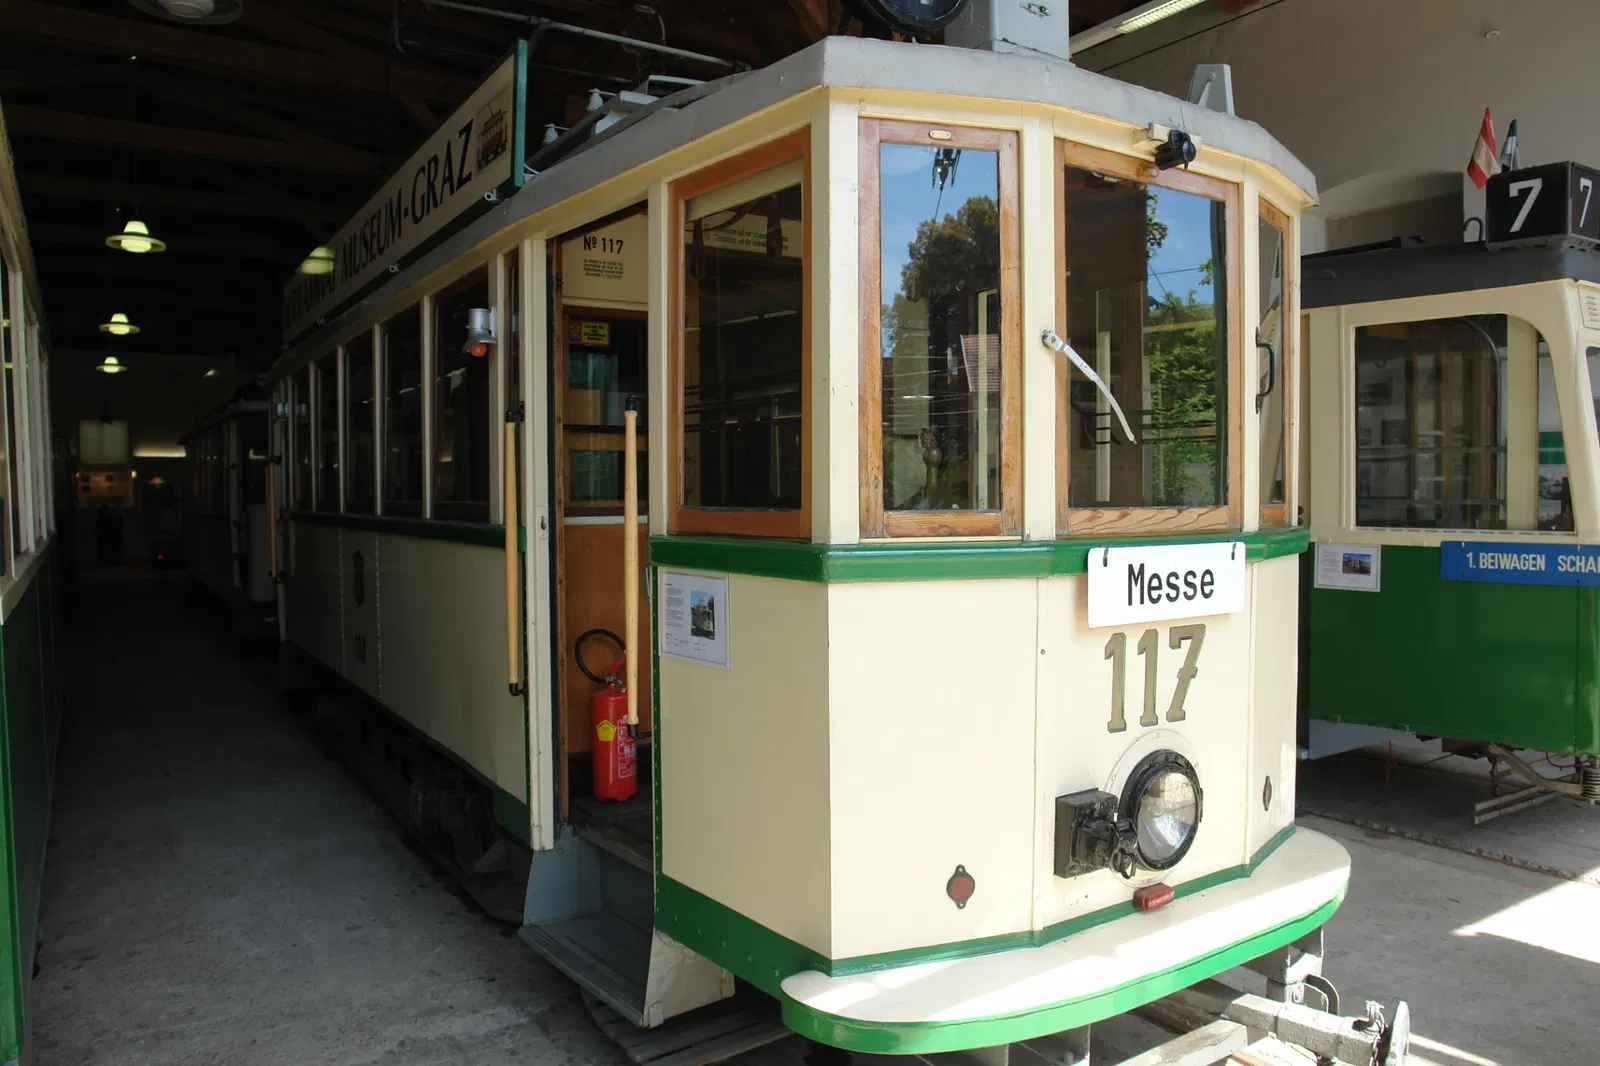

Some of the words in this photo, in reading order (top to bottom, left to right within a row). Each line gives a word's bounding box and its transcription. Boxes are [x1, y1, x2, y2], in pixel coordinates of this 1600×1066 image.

[1508, 177, 1543, 233] 7
[1579, 177, 1593, 228] 7
[601, 237, 624, 254] 117
[1127, 563, 1215, 606] Messe
[1466, 552, 1477, 569] 1.
[1479, 552, 1546, 572] BEIWAGEN
[1104, 623, 1207, 734] 117
